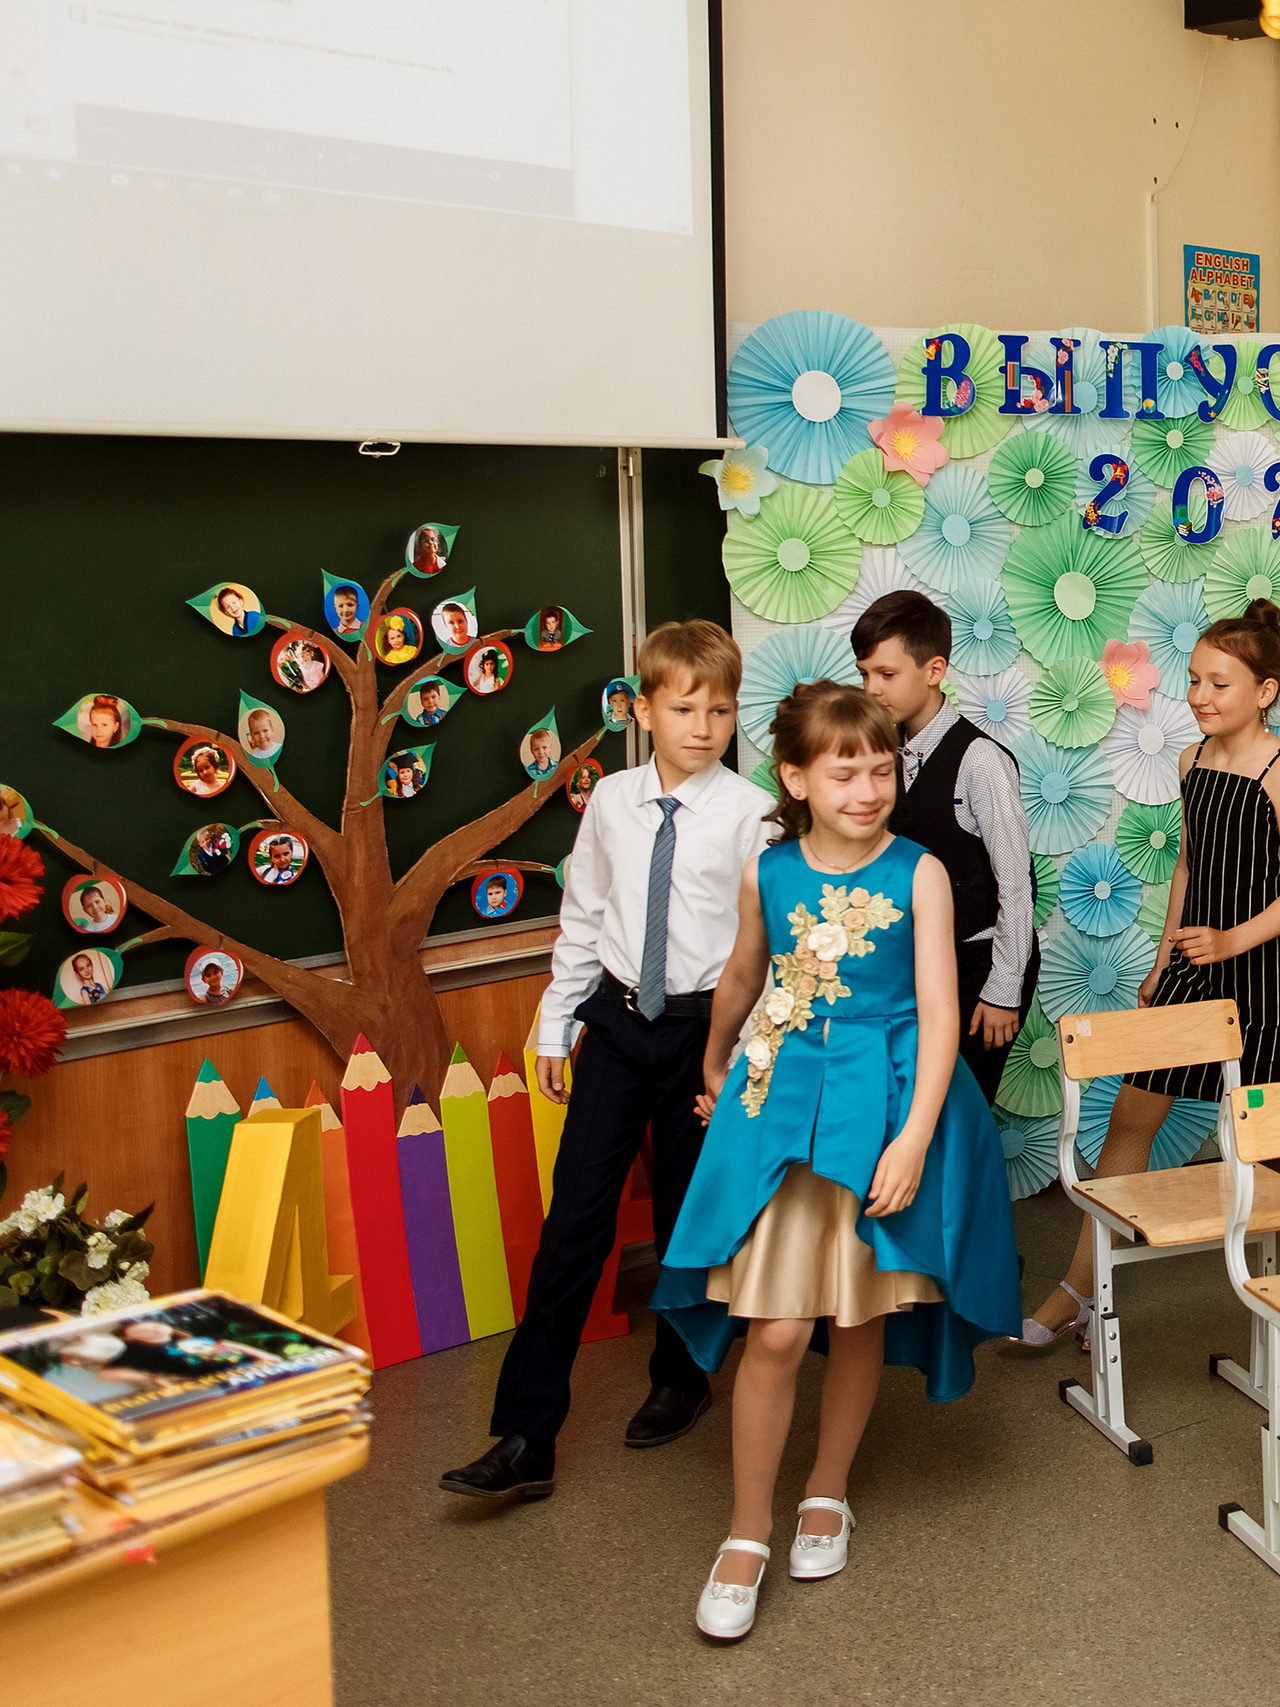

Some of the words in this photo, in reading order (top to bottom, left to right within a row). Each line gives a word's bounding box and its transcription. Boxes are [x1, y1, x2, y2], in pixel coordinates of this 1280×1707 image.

[1195, 252, 1250, 272] ENGLISH
[1190, 268, 1255, 288] ALPHABET
[1203, 289, 1210, 300] B
[1217, 290, 1224, 302] C
[1231, 292, 1237, 303] D
[1204, 309, 1211, 321] G
